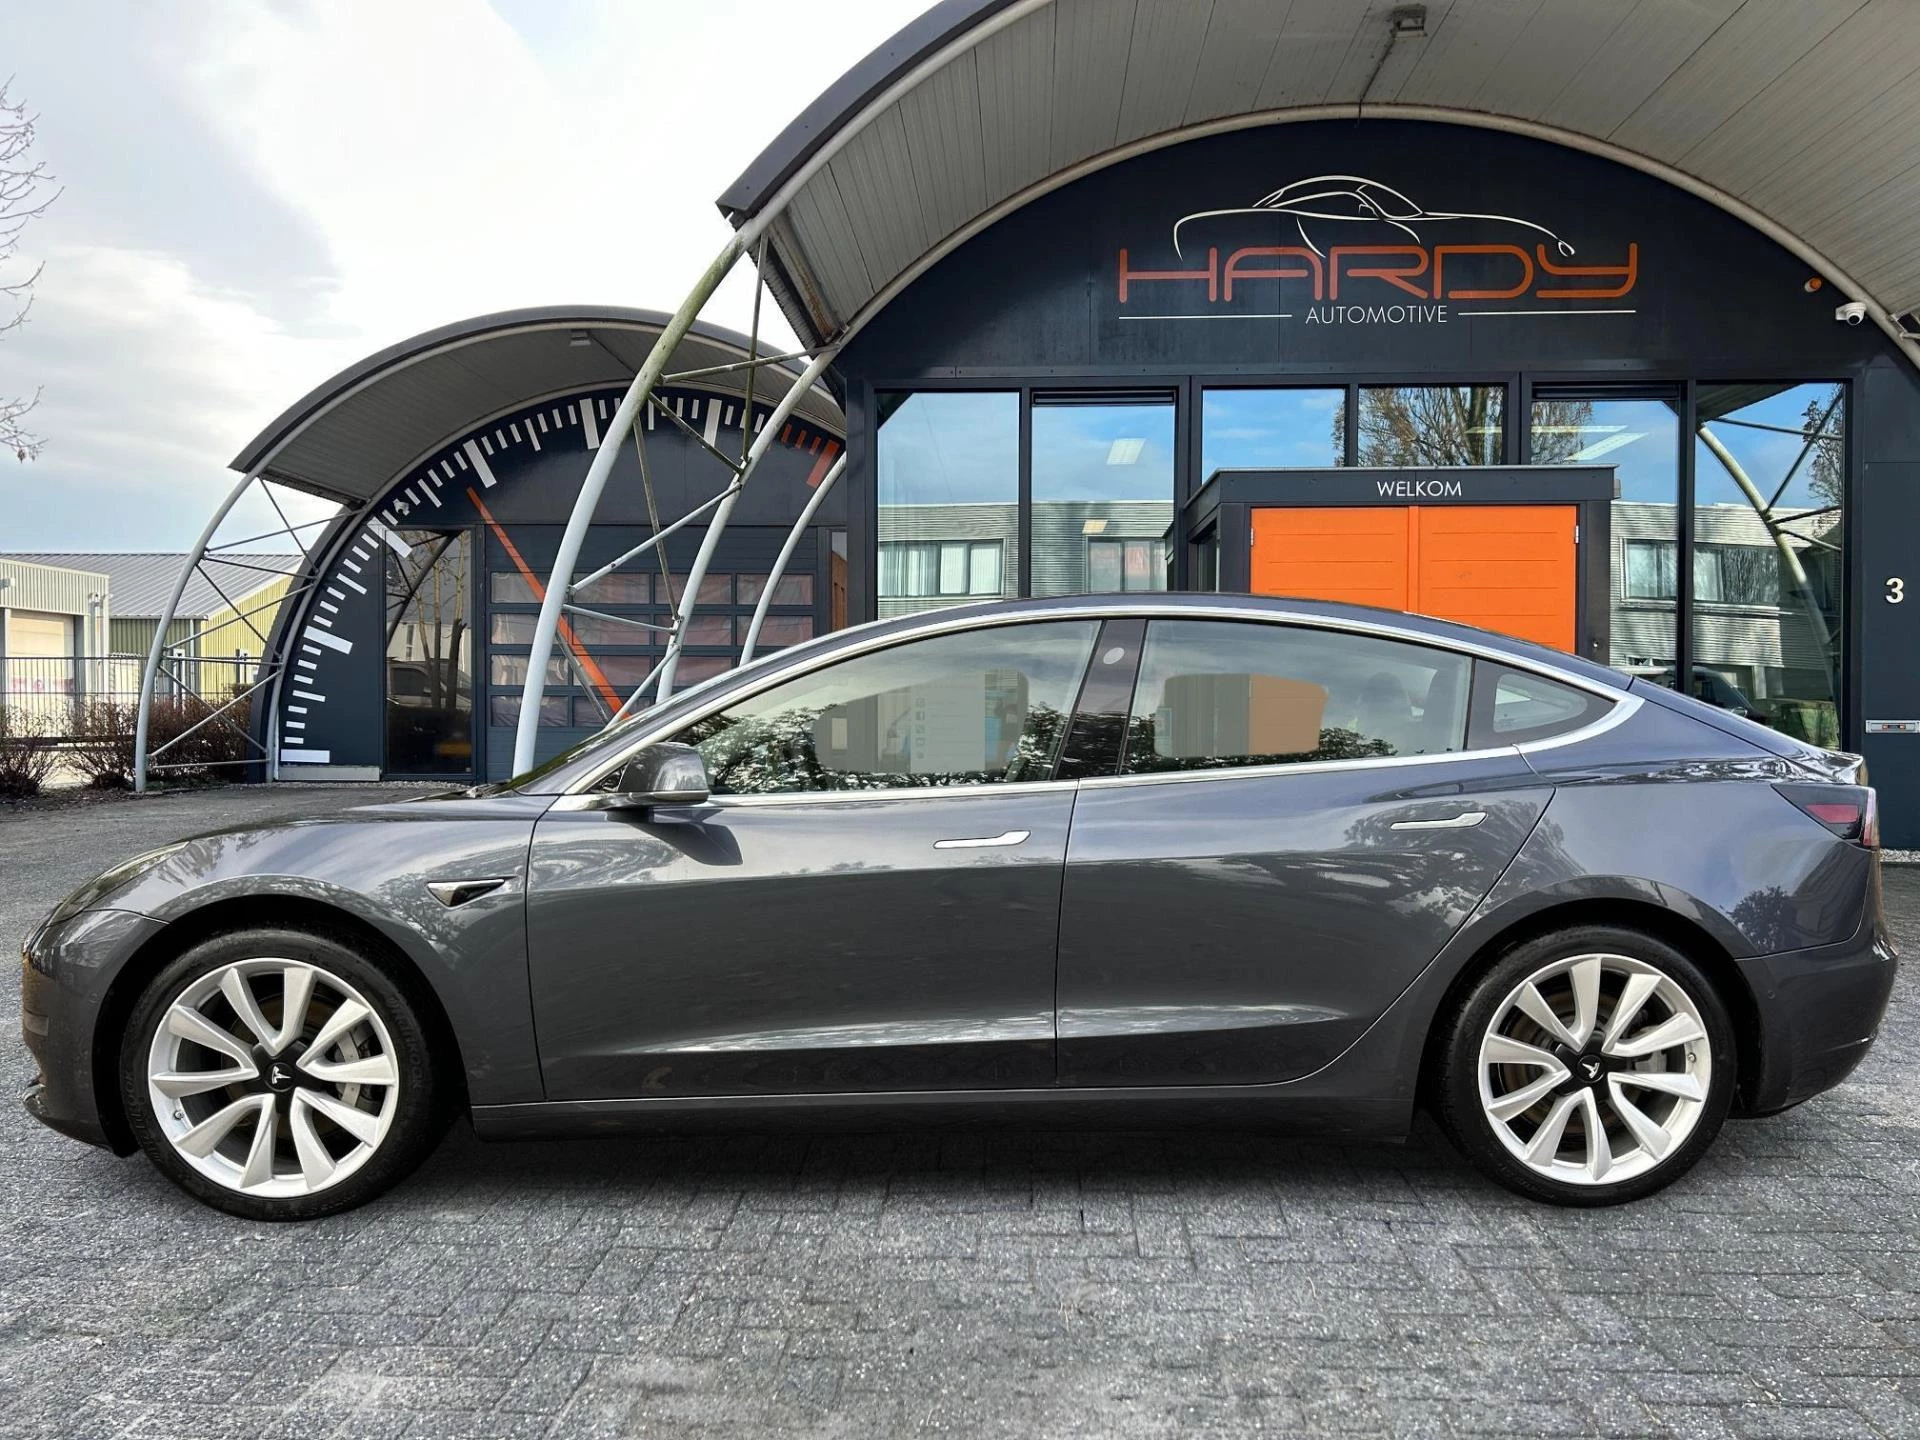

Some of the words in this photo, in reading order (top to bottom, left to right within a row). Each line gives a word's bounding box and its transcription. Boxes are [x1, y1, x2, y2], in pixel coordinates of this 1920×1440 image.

[1119, 242, 1638, 303] HARDY
[1305, 305, 1448, 324] AUTOMOTIVE
[1376, 480, 1463, 497] WELKOM
[1885, 577, 1905, 604] 3
